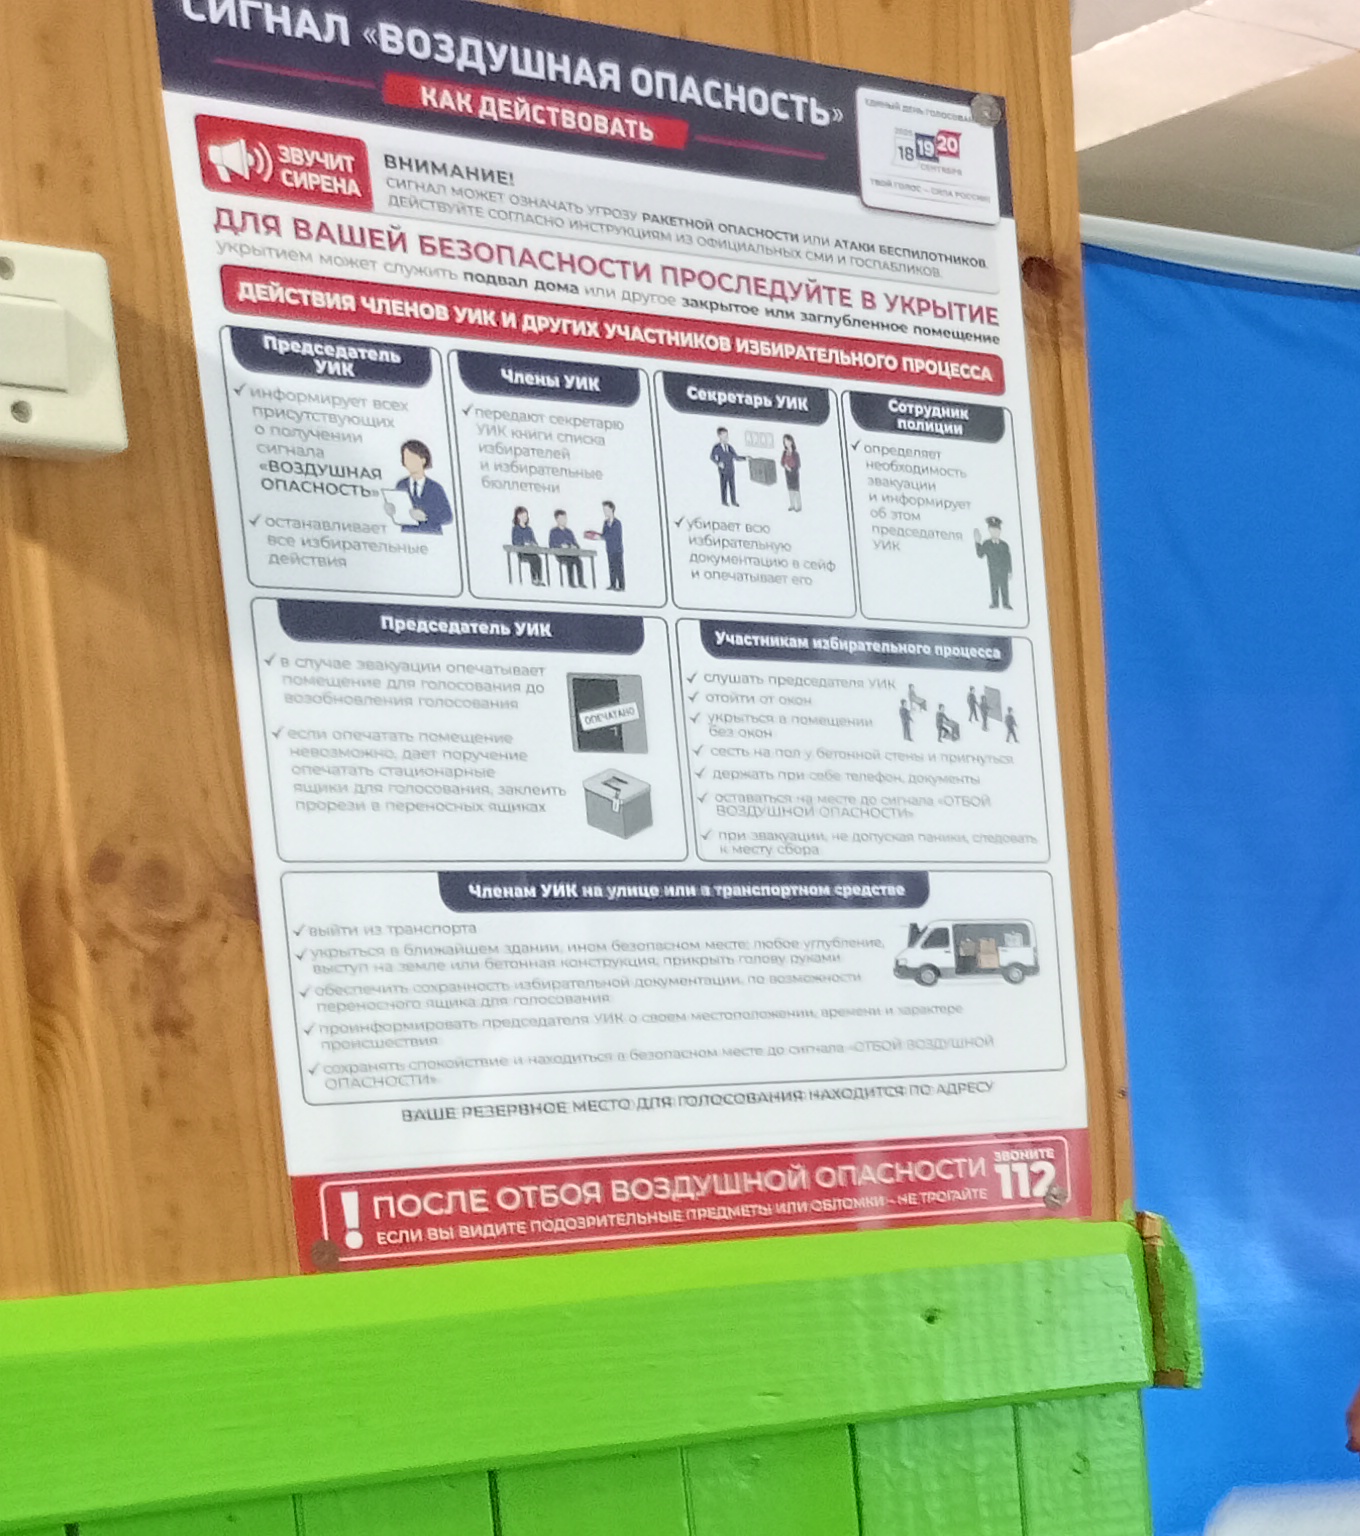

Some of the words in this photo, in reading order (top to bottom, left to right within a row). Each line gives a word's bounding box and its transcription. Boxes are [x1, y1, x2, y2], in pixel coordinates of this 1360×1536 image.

[183, 0, 350, 45] СИГНАЛ
[363, 23, 620, 89] «ВОЗДУШНАЯ
[630, 68, 842, 124] ОПАСНОСТЬ»
[419, 85, 472, 113] КАК
[477, 96, 654, 140] ДЕЙСТВОВАТЬ
[277, 145, 354, 172] ЗВУЧИТ
[898, 145, 914, 162] 18
[916, 138, 934, 158] 19
[936, 135, 959, 153] 20
[383, 154, 513, 185] ВНИМАНИЕ!
[280, 168, 360, 196] СИРЕНА
[385, 177, 446, 194] СИГНАЛ
[450, 187, 503, 202] МОЖЕТ
[508, 194, 583, 214] ОЗНАЧАТЬ
[587, 206, 637, 219] УГРОЗУ
[641, 212, 714, 230] РАКЕТНОЙ
[717, 223, 799, 242] ОПАСНОСТИ
[802, 235, 830, 246] ИЛИ
[833, 239, 875, 252] АТАКИ
[878, 244, 986, 268] БЕСПИЛОТНИКОВ.
[387, 194, 484, 217] ДЕЙСТВУЙТЕ
[487, 208, 565, 228] СОГЛАСНО
[568, 220, 672, 241] ИНСТРУКЦИЯМ
[675, 234, 693, 245] ИЗ
[696, 236, 801, 258] ОФИЦИАЛЬНЫХ
[804, 250, 834, 263] СМИ
[836, 255, 846, 264] И
[849, 256, 940, 277] ГОСПАБЛИКОВ.
[213, 207, 281, 236] ДЛЯ
[292, 218, 407, 252] ВАШЕЙ
[418, 235, 651, 281] БЕЗОПАСНОСТИ
[660, 266, 852, 307] ПРОСЛЕДУЙТЕ
[860, 290, 876, 310] В
[884, 294, 998, 326] УКРЫТИЕ
[217, 244, 312, 258] укрытием
[319, 255, 375, 267] может
[383, 263, 457, 279] служить
[462, 271, 528, 288] подвал
[533, 280, 579, 294] дома
[584, 287, 615, 297] или
[621, 290, 675, 304] другое
[681, 297, 759, 315] закрытое
[764, 307, 795, 319] или
[800, 312, 908, 333] заглубленное
[912, 325, 1000, 344] помещение
[237, 281, 356, 310] ДЕЙСТВИЯ
[360, 296, 449, 321] ЧЛЕНОВ
[453, 306, 496, 326] УИК
[500, 311, 517, 329] И
[521, 314, 599, 337] ДРУГИХ
[603, 323, 731, 351] УЧАСТНИКОВ
[735, 338, 898, 369] ИЗБИРАТЕЛЬНОГО
[901, 357, 992, 380] ПРОЦЕССА
[262, 335, 401, 362] Председатель
[314, 359, 354, 377] УИК
[500, 368, 560, 387] Члены
[563, 375, 600, 391] УИК
[249, 388, 367, 409] информирует
[372, 399, 408, 411] всех
[686, 386, 772, 408] Секретарь
[775, 395, 808, 411] УИК
[251, 406, 394, 427] присутствующих
[887, 399, 969, 419] Сотрудник
[474, 408, 544, 423] передают
[548, 415, 624, 431] секретарю
[896, 418, 963, 434] полиции
[254, 425, 265, 435] о
[269, 426, 363, 443] получении
[476, 423, 507, 436] УИК
[510, 429, 553, 440] книги
[556, 432, 606, 446] списка
[255, 443, 324, 458] сигнала
[477, 441, 570, 459] избирателей
[863, 444, 941, 459] определяет
[259, 460, 382, 479] «ВОЗДУШНАЯ
[479, 461, 489, 470] и
[493, 460, 603, 480] избирательные
[865, 460, 966, 478] необходимость
[260, 478, 380, 497] ОПАСНОСТЬ»
[480, 475, 560, 492] бюллетени
[867, 477, 936, 491] эвакуации
[868, 493, 877, 501] и
[880, 493, 971, 512] информирует
[869, 506, 887, 519] об
[890, 510, 921, 521] этом
[264, 517, 386, 534] останавливает
[686, 517, 740, 532] убирает
[744, 523, 770, 534] всю
[871, 525, 963, 540] председателя
[266, 534, 295, 547] все
[300, 535, 428, 554] избирательные
[687, 534, 791, 552] избирательную
[873, 539, 900, 551] УИК
[267, 552, 347, 567] действия
[688, 553, 788, 568] документацию
[791, 559, 800, 569] в
[802, 559, 836, 572] сейф
[690, 569, 700, 579] и
[702, 570, 787, 584] опечатывает
[790, 575, 812, 585] его
[380, 615, 510, 635] Председатель
[514, 622, 551, 637] УИК
[714, 631, 809, 648] Участникам
[811, 637, 931, 654] избирательного
[934, 645, 1001, 659] процесса
[584, 706, 636, 727] ОПЕЧАТАНО
[468, 884, 536, 898] Членам
[540, 883, 577, 897] УИК
[581, 885, 603, 897] на
[605, 885, 662, 899] улице
[661, 885, 698, 896] или
[699, 885, 711, 896] в
[712, 885, 831, 898] транспортном
[833, 885, 905, 897] средстве
[401, 1107, 456, 1122] ВАШЕ
[461, 1101, 567, 1118] РЕЗЕРВНОЕ
[572, 1098, 634, 1112] МЕСТО
[633, 1096, 675, 1110] ДЛЯ
[677, 1090, 806, 1107] ГОЛОСОВАНИЯ
[808, 1085, 906, 1100] НАХОДИТСЯ
[908, 1084, 931, 1095] ПО
[936, 1081, 993, 1095] АДРЕСУ
[993, 1147, 1054, 1161] ЗВОНИТЕ
[372, 1189, 489, 1218] ПОСЛЕ
[496, 1181, 602, 1210] ОТБОЯ
[610, 1165, 810, 1201] ВОЗДУШНОЙ
[814, 1158, 985, 1187] ОПАСНОСТИ
[994, 1162, 1056, 1200] 112
[375, 1228, 422, 1245] ЕСЛИ
[426, 1226, 454, 1240] ВЫ
[457, 1221, 527, 1238] ВИДИТЕ
[529, 1209, 683, 1232] ПОДОЗРИТЕЛЬНЫЕ
[685, 1204, 774, 1220] ПРЕДМЕТЫ
[773, 1201, 809, 1214] ИЛИ
[808, 1196, 889, 1211] ОБЛОМКИ
[896, 1192, 917, 1205] НЕ
[918, 1187, 987, 1203] ТРОГАЙТЕ
